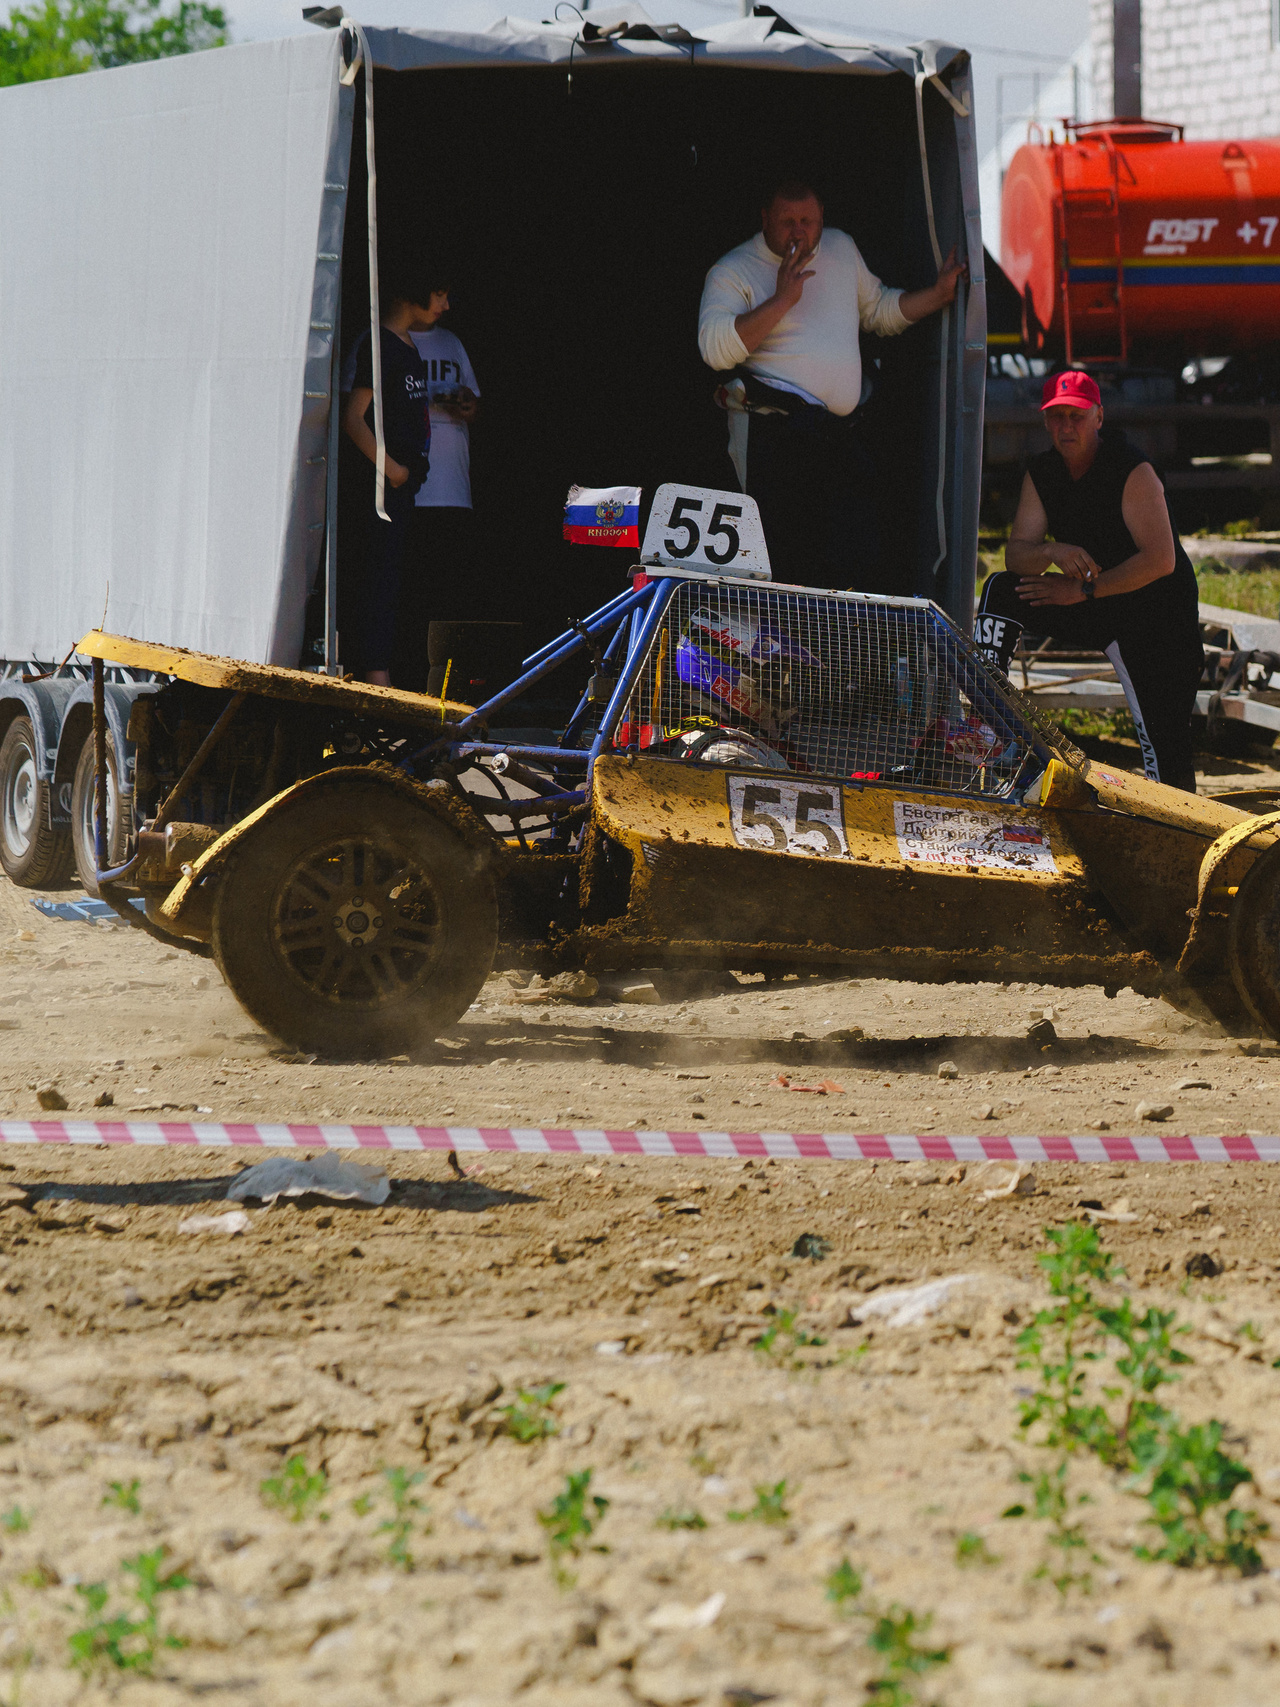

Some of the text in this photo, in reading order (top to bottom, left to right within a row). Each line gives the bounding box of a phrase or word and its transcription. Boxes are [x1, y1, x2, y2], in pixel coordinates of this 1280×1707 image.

[1146, 218, 1219, 243] FOST
[1236, 216, 1279, 248] +7
[664, 497, 742, 565] 55
[742, 785, 842, 856] 55
[902, 804, 990, 826] Евстратов
